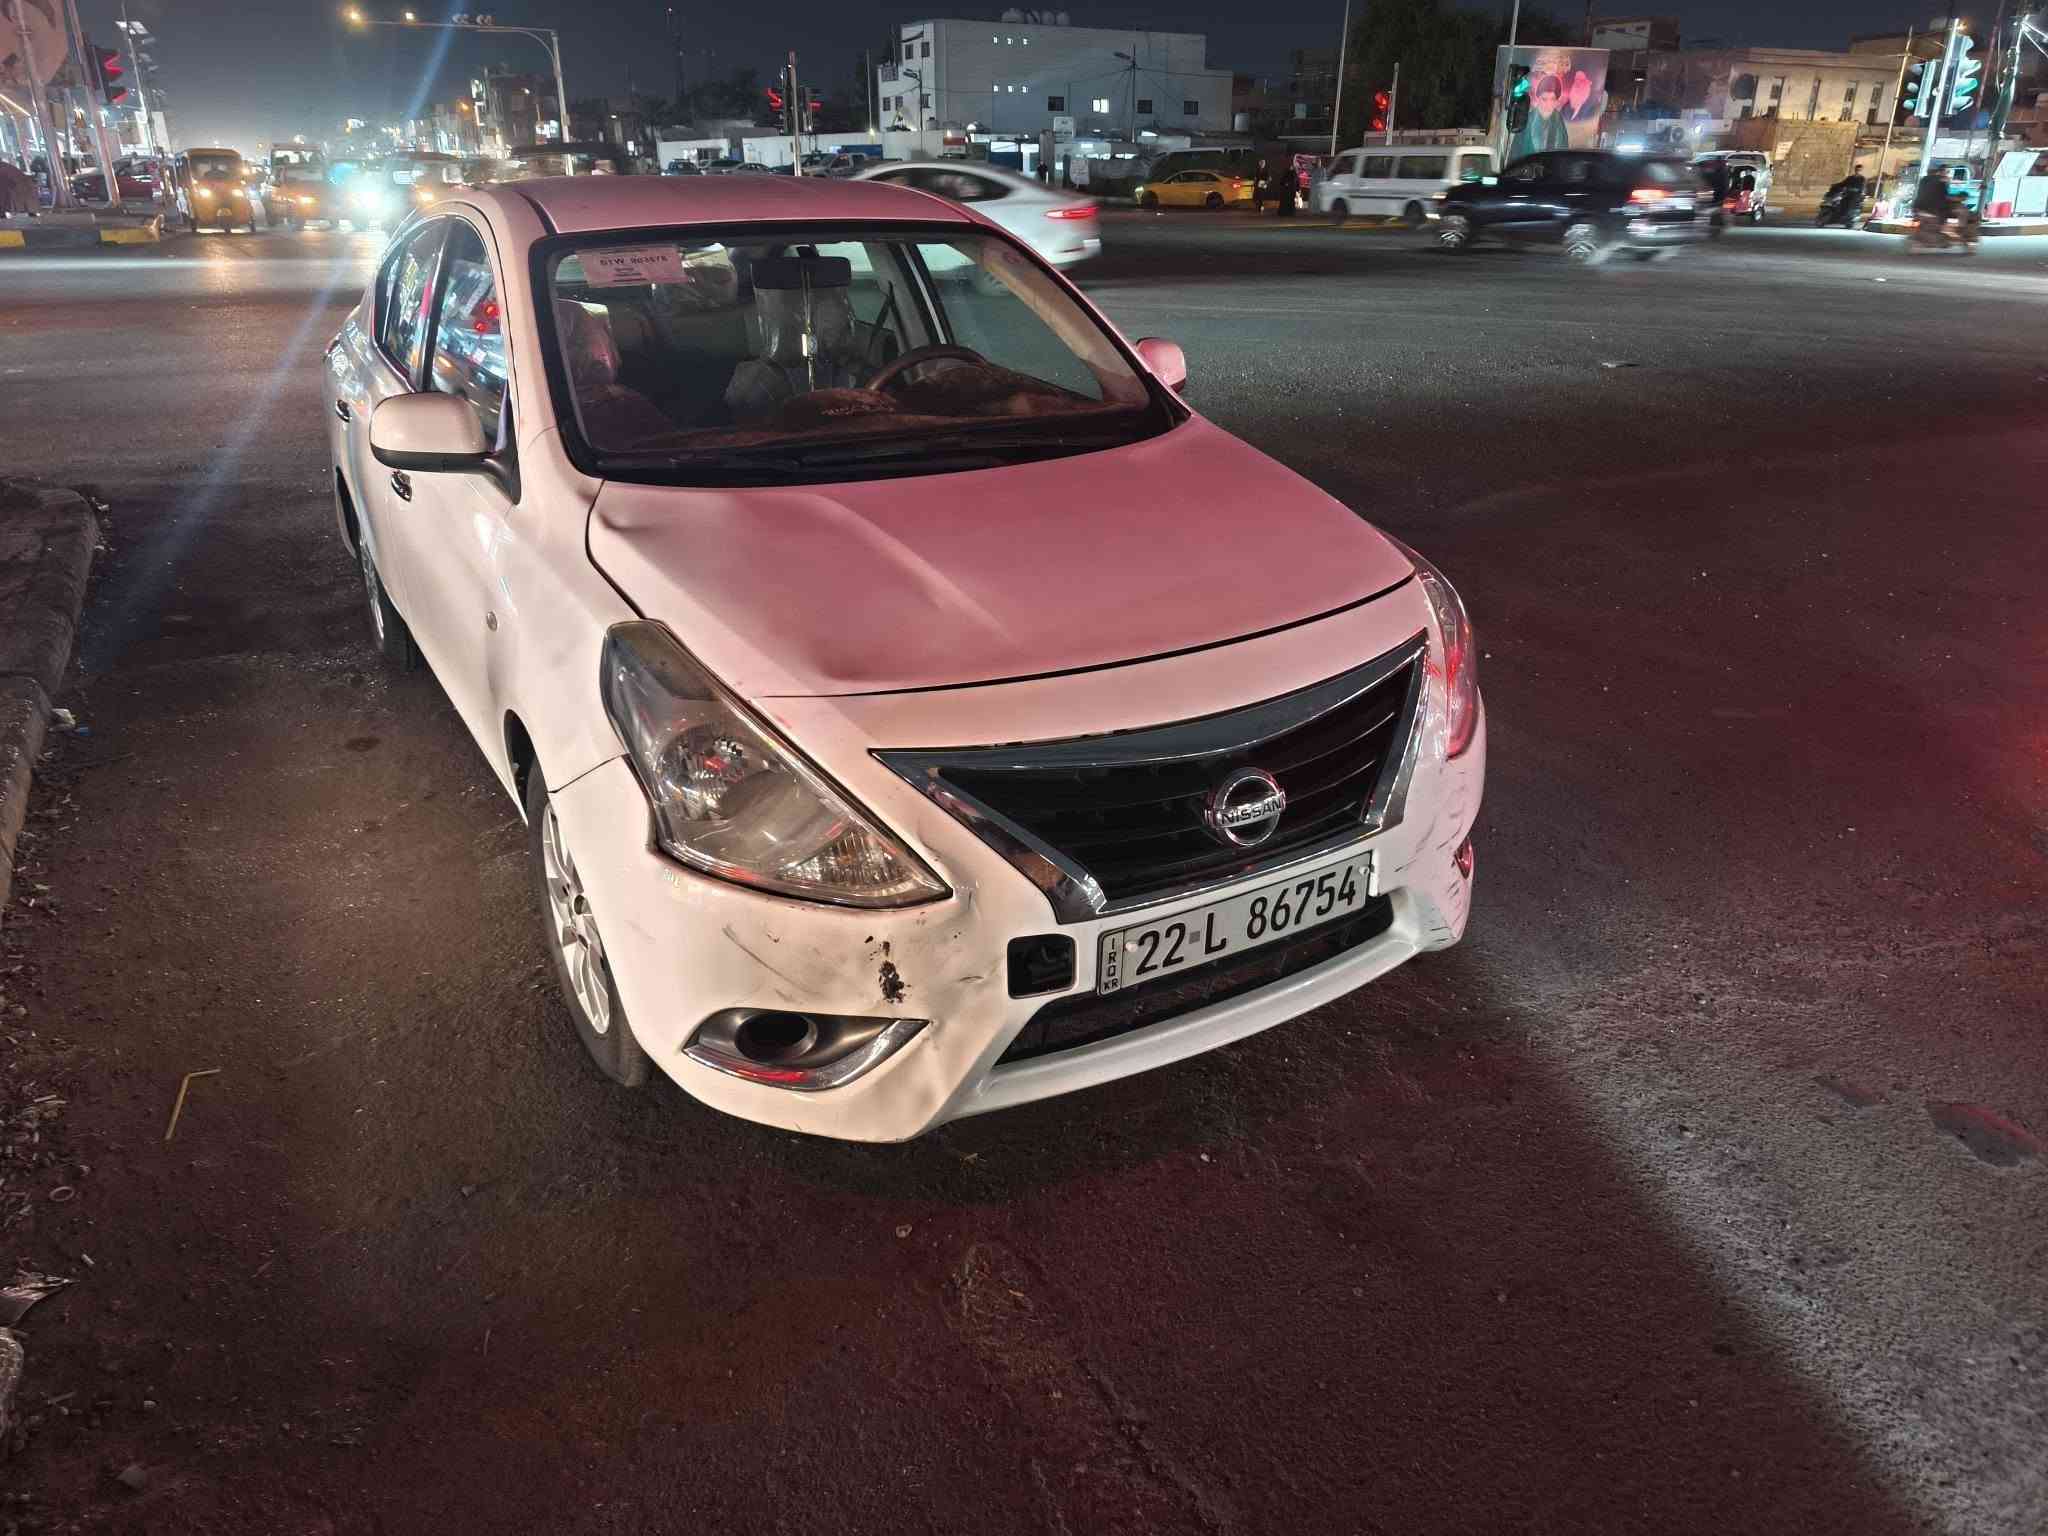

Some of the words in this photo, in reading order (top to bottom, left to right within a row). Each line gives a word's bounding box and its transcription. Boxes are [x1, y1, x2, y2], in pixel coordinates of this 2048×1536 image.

[1221, 800, 1280, 823] NISSAN
[1135, 922, 1186, 977] 22
[1203, 912, 1228, 955] L
[1246, 865, 1356, 940] 86754
[1103, 978, 1120, 991] KR
